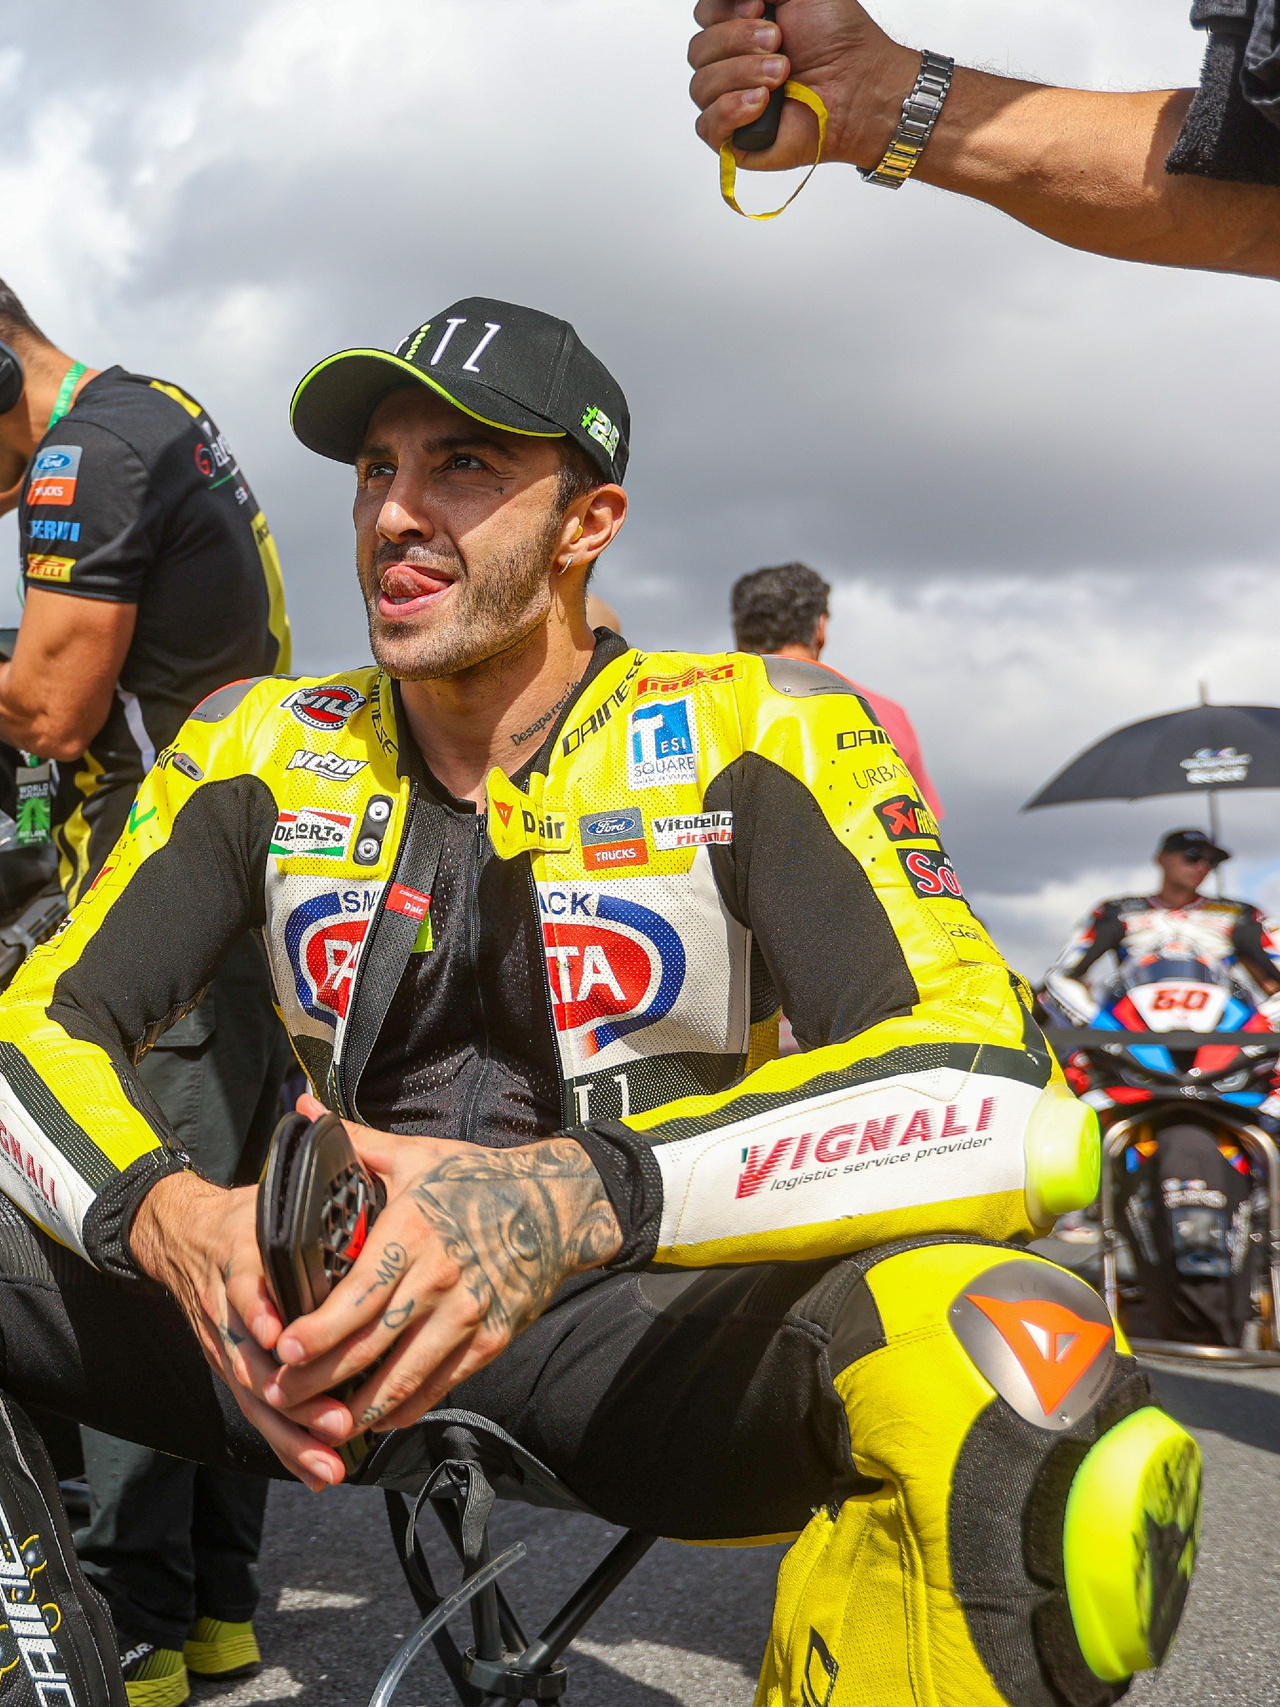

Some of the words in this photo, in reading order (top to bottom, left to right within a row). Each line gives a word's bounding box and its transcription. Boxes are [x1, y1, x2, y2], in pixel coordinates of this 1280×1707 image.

[634, 756, 695, 777] SQUARE
[596, 817, 627, 834] Ford
[595, 848, 637, 862] TRUCKS
[735, 1096, 999, 1199] VIGNALI
[770, 1167, 837, 1191] logistic
[844, 1151, 911, 1175] service
[914, 1136, 992, 1163] provider
